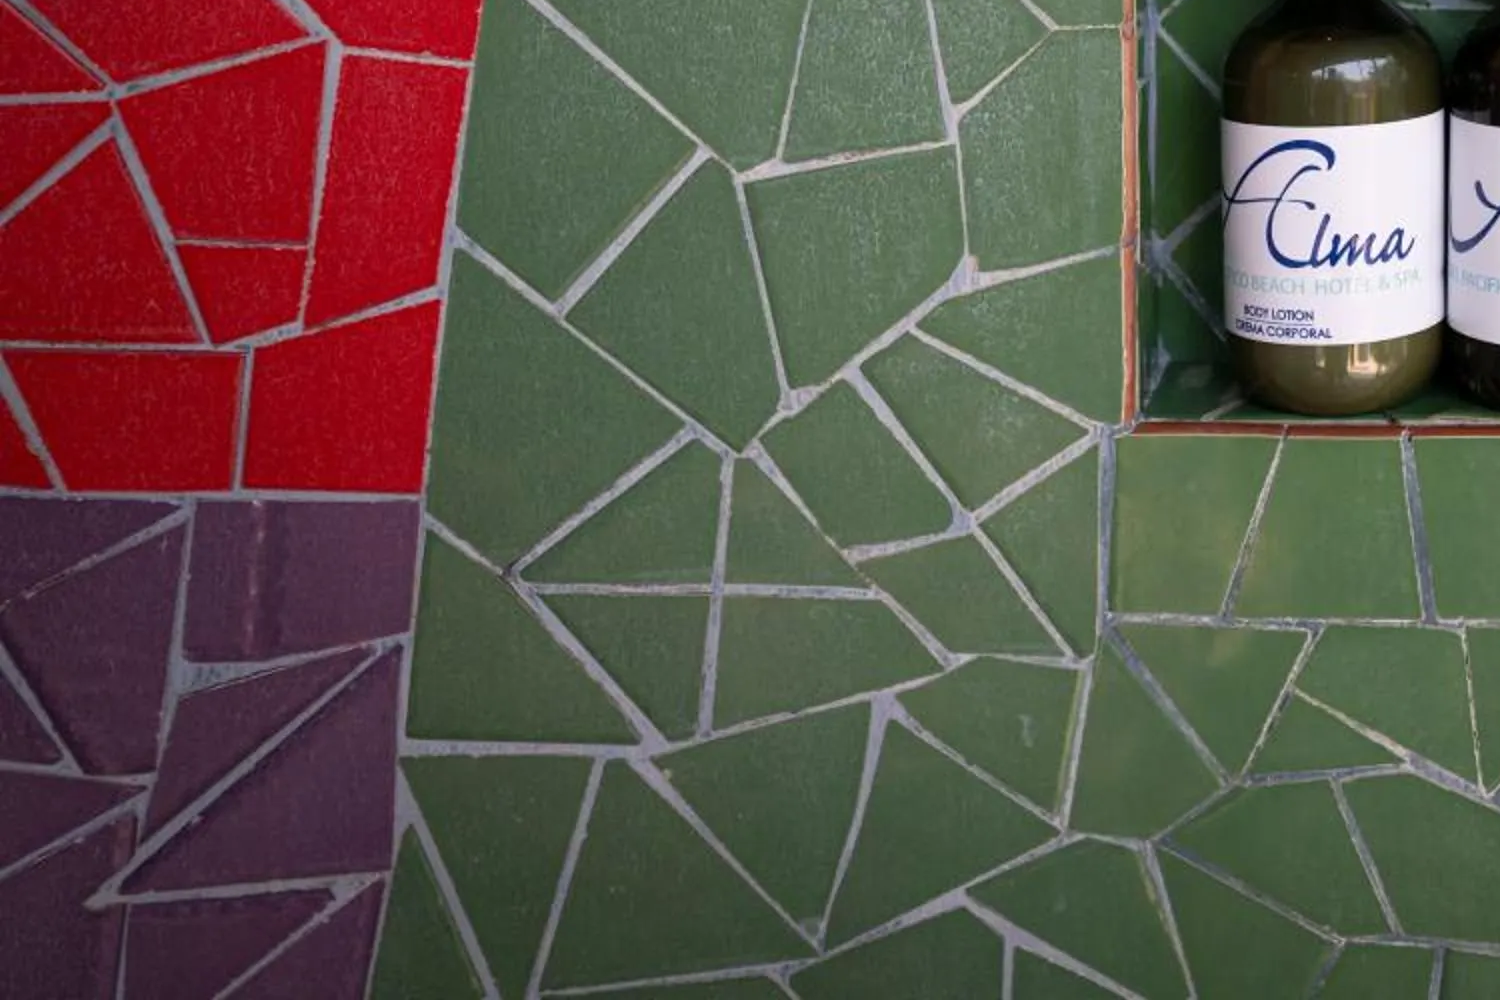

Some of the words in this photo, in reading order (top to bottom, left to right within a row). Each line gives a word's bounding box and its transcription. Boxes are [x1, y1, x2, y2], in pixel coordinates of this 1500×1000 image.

[1250, 274, 1305, 296] BEACH
[1315, 276, 1370, 297] HOTEL
[1378, 275, 1390, 292] &
[1394, 270, 1423, 292] SPA
[1244, 303, 1269, 319] BODY
[1272, 307, 1315, 321] LOTION
[1235, 319, 1264, 336] CREMA
[1266, 323, 1333, 339] CORPORAL
